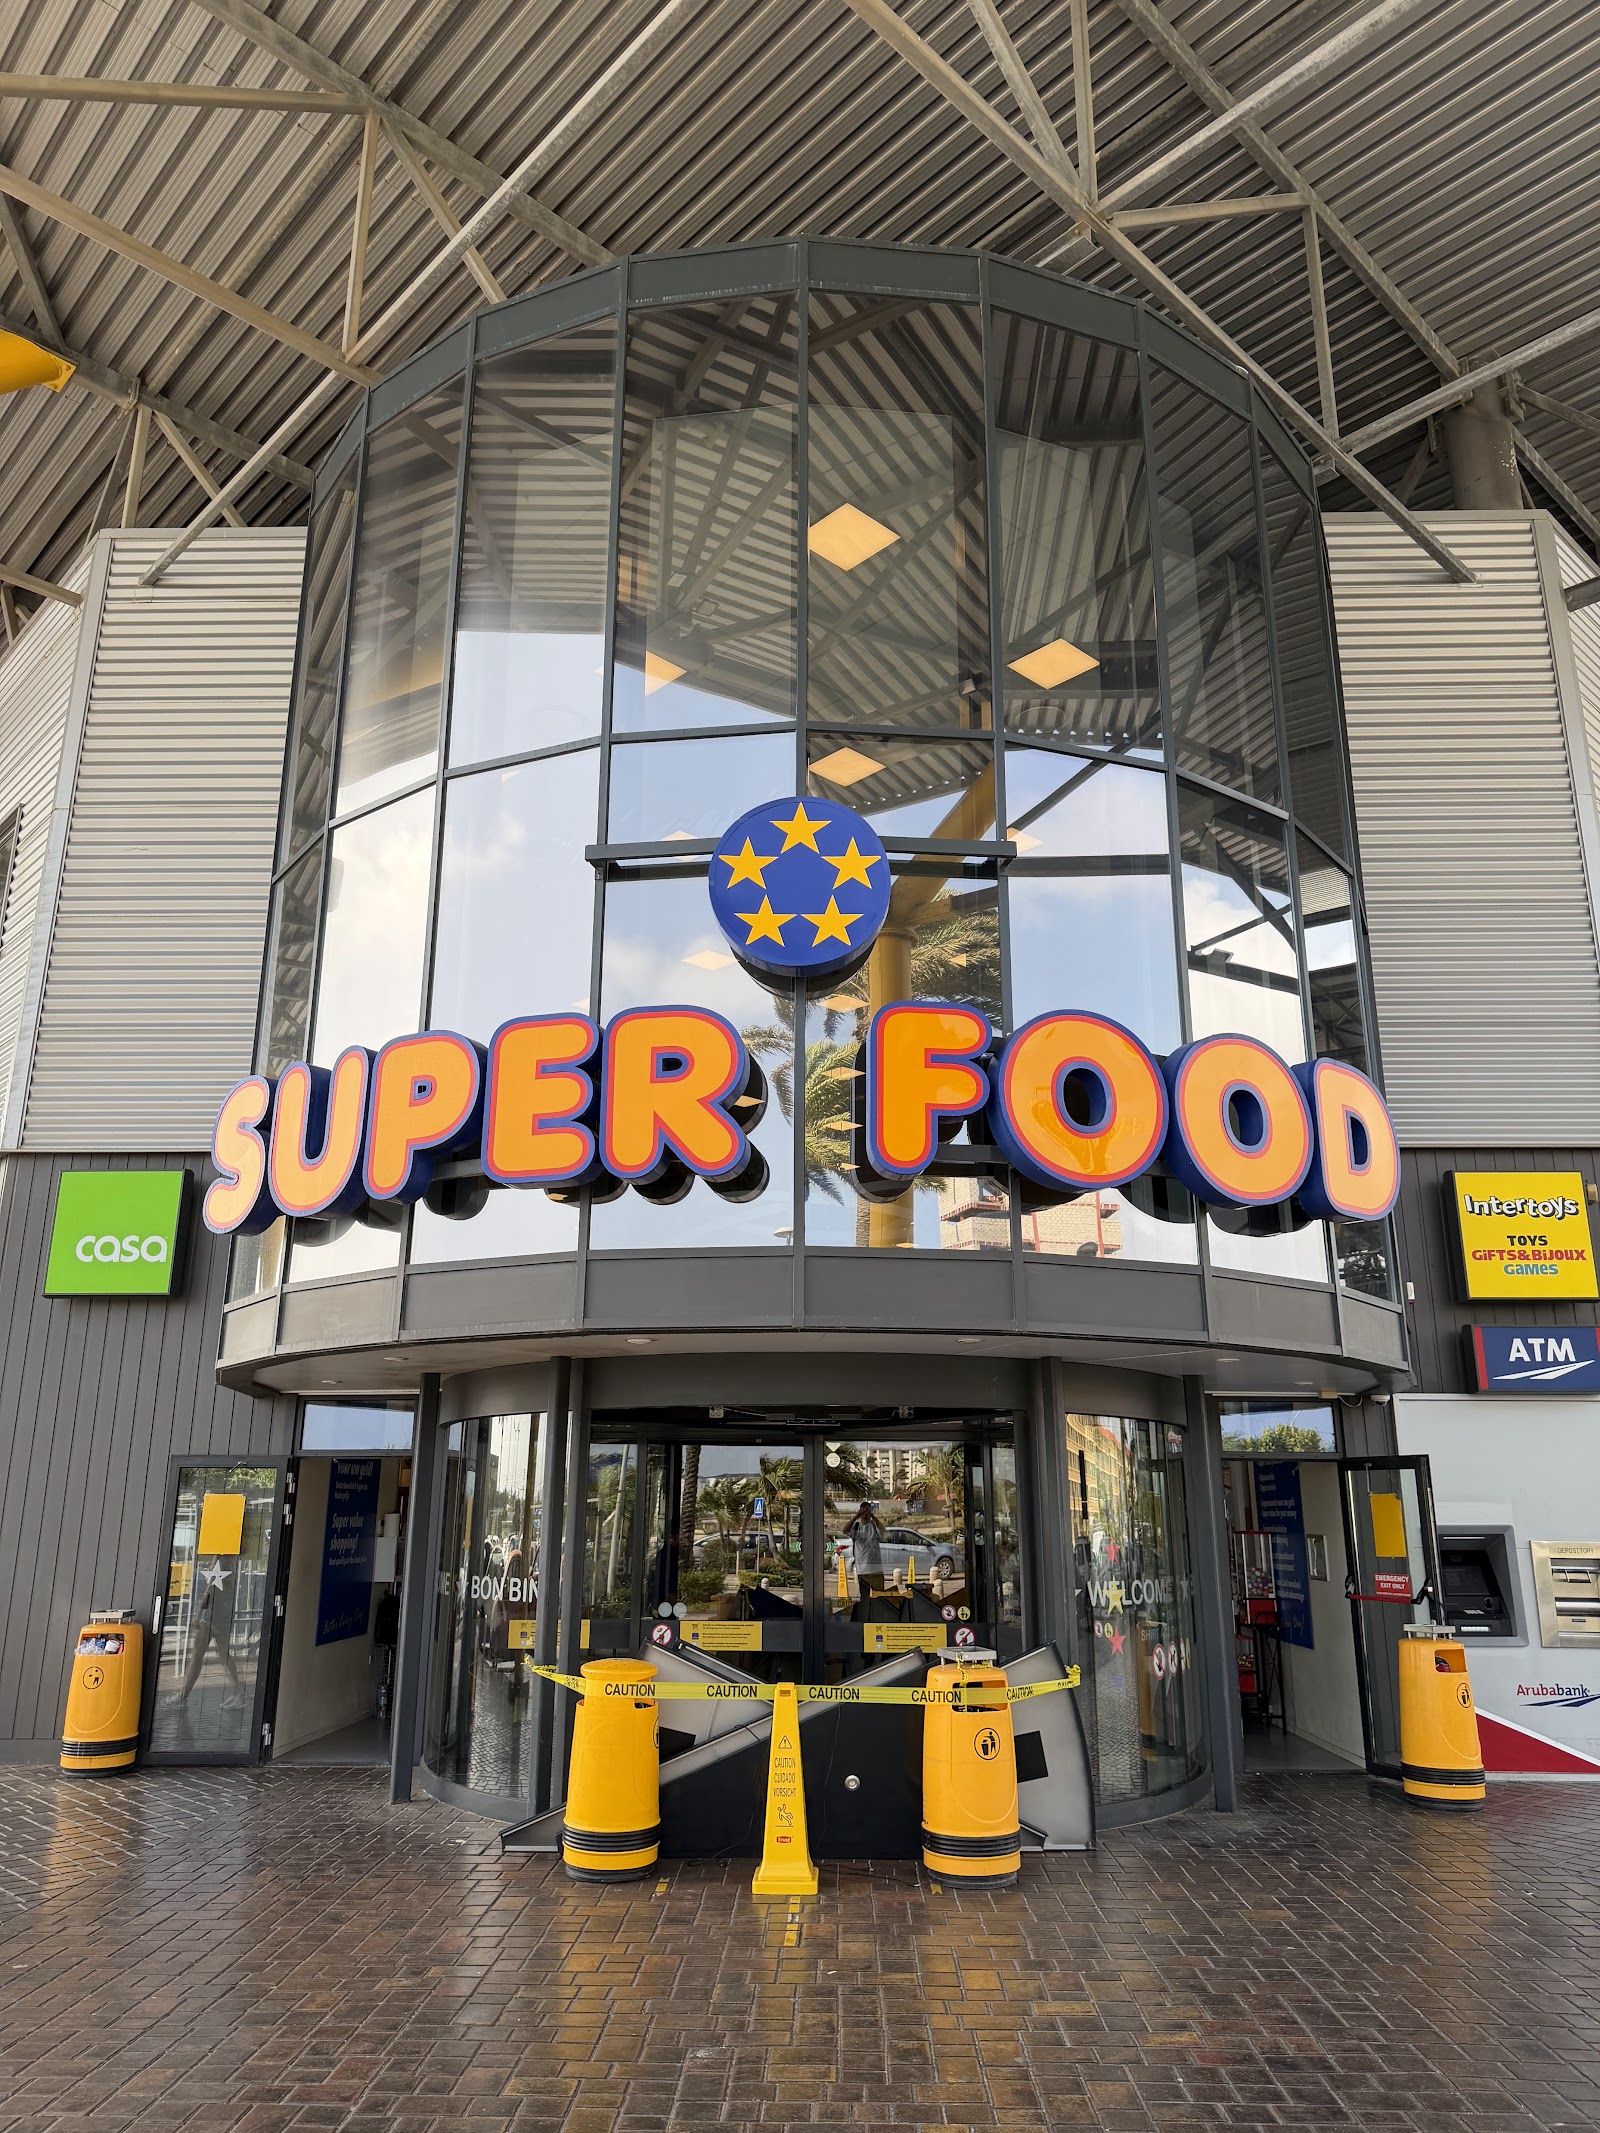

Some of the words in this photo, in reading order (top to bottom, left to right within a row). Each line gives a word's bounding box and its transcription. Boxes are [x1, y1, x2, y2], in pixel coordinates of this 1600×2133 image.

[203, 1005, 752, 1234] SUPER
[866, 1002, 1400, 1222] FOOD
[1463, 1194, 1579, 1221] Intertoys
[75, 1234, 168, 1263] casa
[1506, 1235, 1548, 1246] TOYS
[1508, 1337, 1577, 1362] ATM
[332, 1512, 349, 1533] Super
[1375, 1574, 1409, 1583] EMERGENCY
[471, 1575, 505, 1601] BON
[508, 1577, 539, 1603] BIN
[604, 1683, 656, 1697] CAUTION
[706, 1685, 758, 1698] CAUTION
[808, 1687, 860, 1701] CAUTION
[911, 1689, 962, 1703] CAUTION
[1516, 1684, 1589, 1697] Arubabank
[774, 1757, 796, 1768] CAUTION
[774, 1772, 796, 1784] CUIDADO
[772, 1787, 797, 1798] VORSICHT
